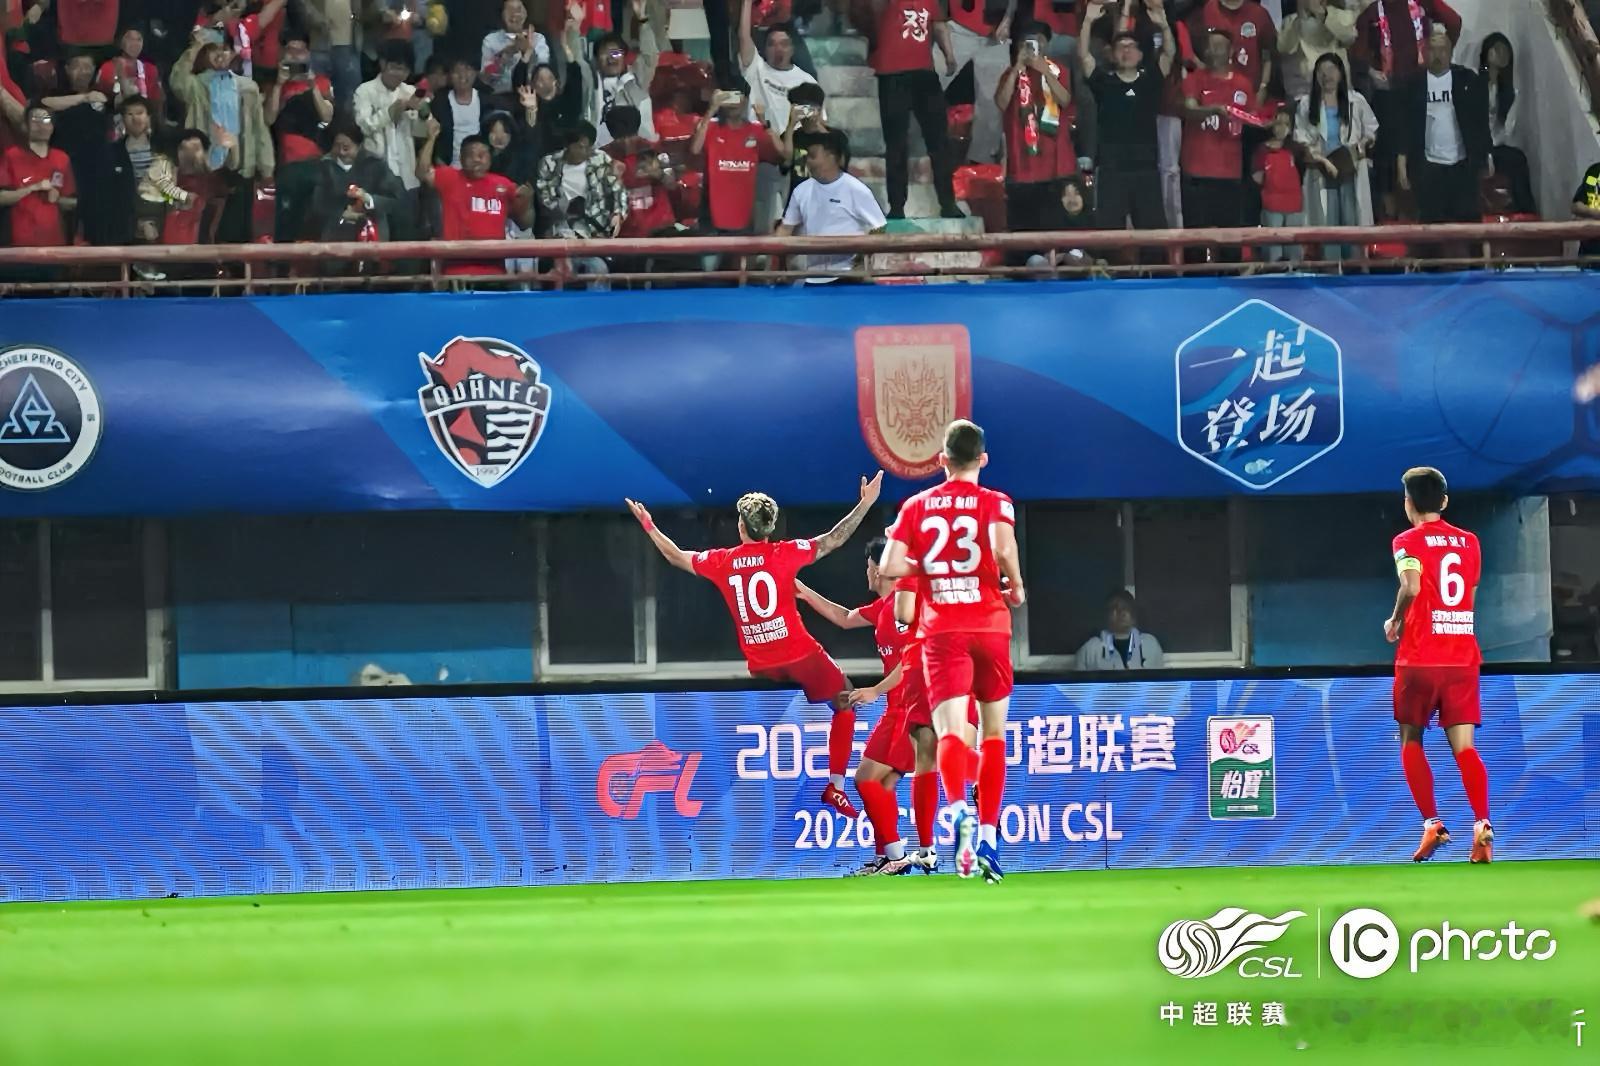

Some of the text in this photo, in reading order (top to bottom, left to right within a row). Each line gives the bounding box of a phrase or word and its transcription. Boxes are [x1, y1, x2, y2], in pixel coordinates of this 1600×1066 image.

[1189, 324, 1306, 388] 一起
[1200, 387, 1317, 456] 登场
[921, 515, 982, 575] 23
[728, 570, 778, 623] 10
[1440, 552, 1465, 607] 6
[1061, 802, 1124, 842] CSL
